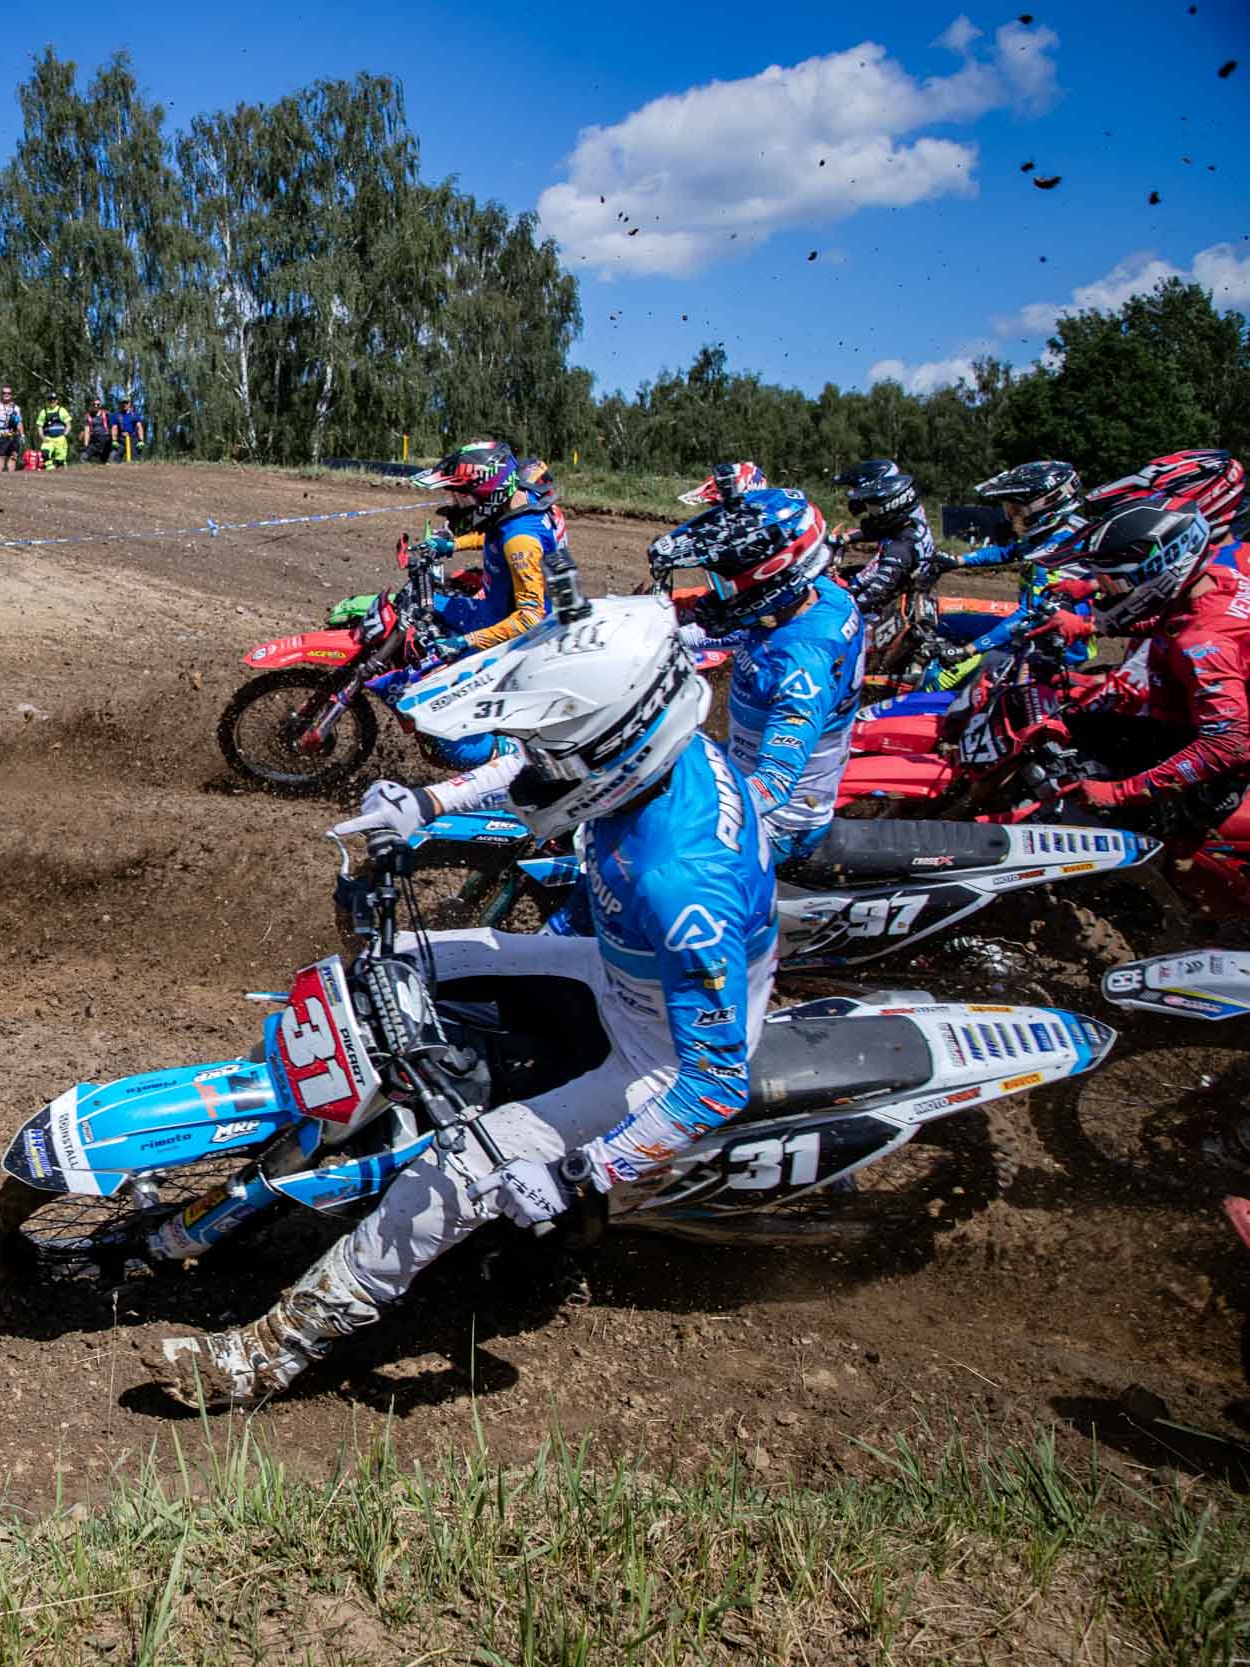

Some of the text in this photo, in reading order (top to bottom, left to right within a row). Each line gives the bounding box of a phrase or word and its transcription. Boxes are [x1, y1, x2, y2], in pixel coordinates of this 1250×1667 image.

[473, 699, 504, 719] 31
[846, 892, 930, 937] 97
[281, 996, 352, 1109] 31
[339, 1027, 366, 1086] PIKART
[140, 1132, 192, 1150] rimoto
[211, 1119, 262, 1143] MRP
[727, 1132, 820, 1190] 31
